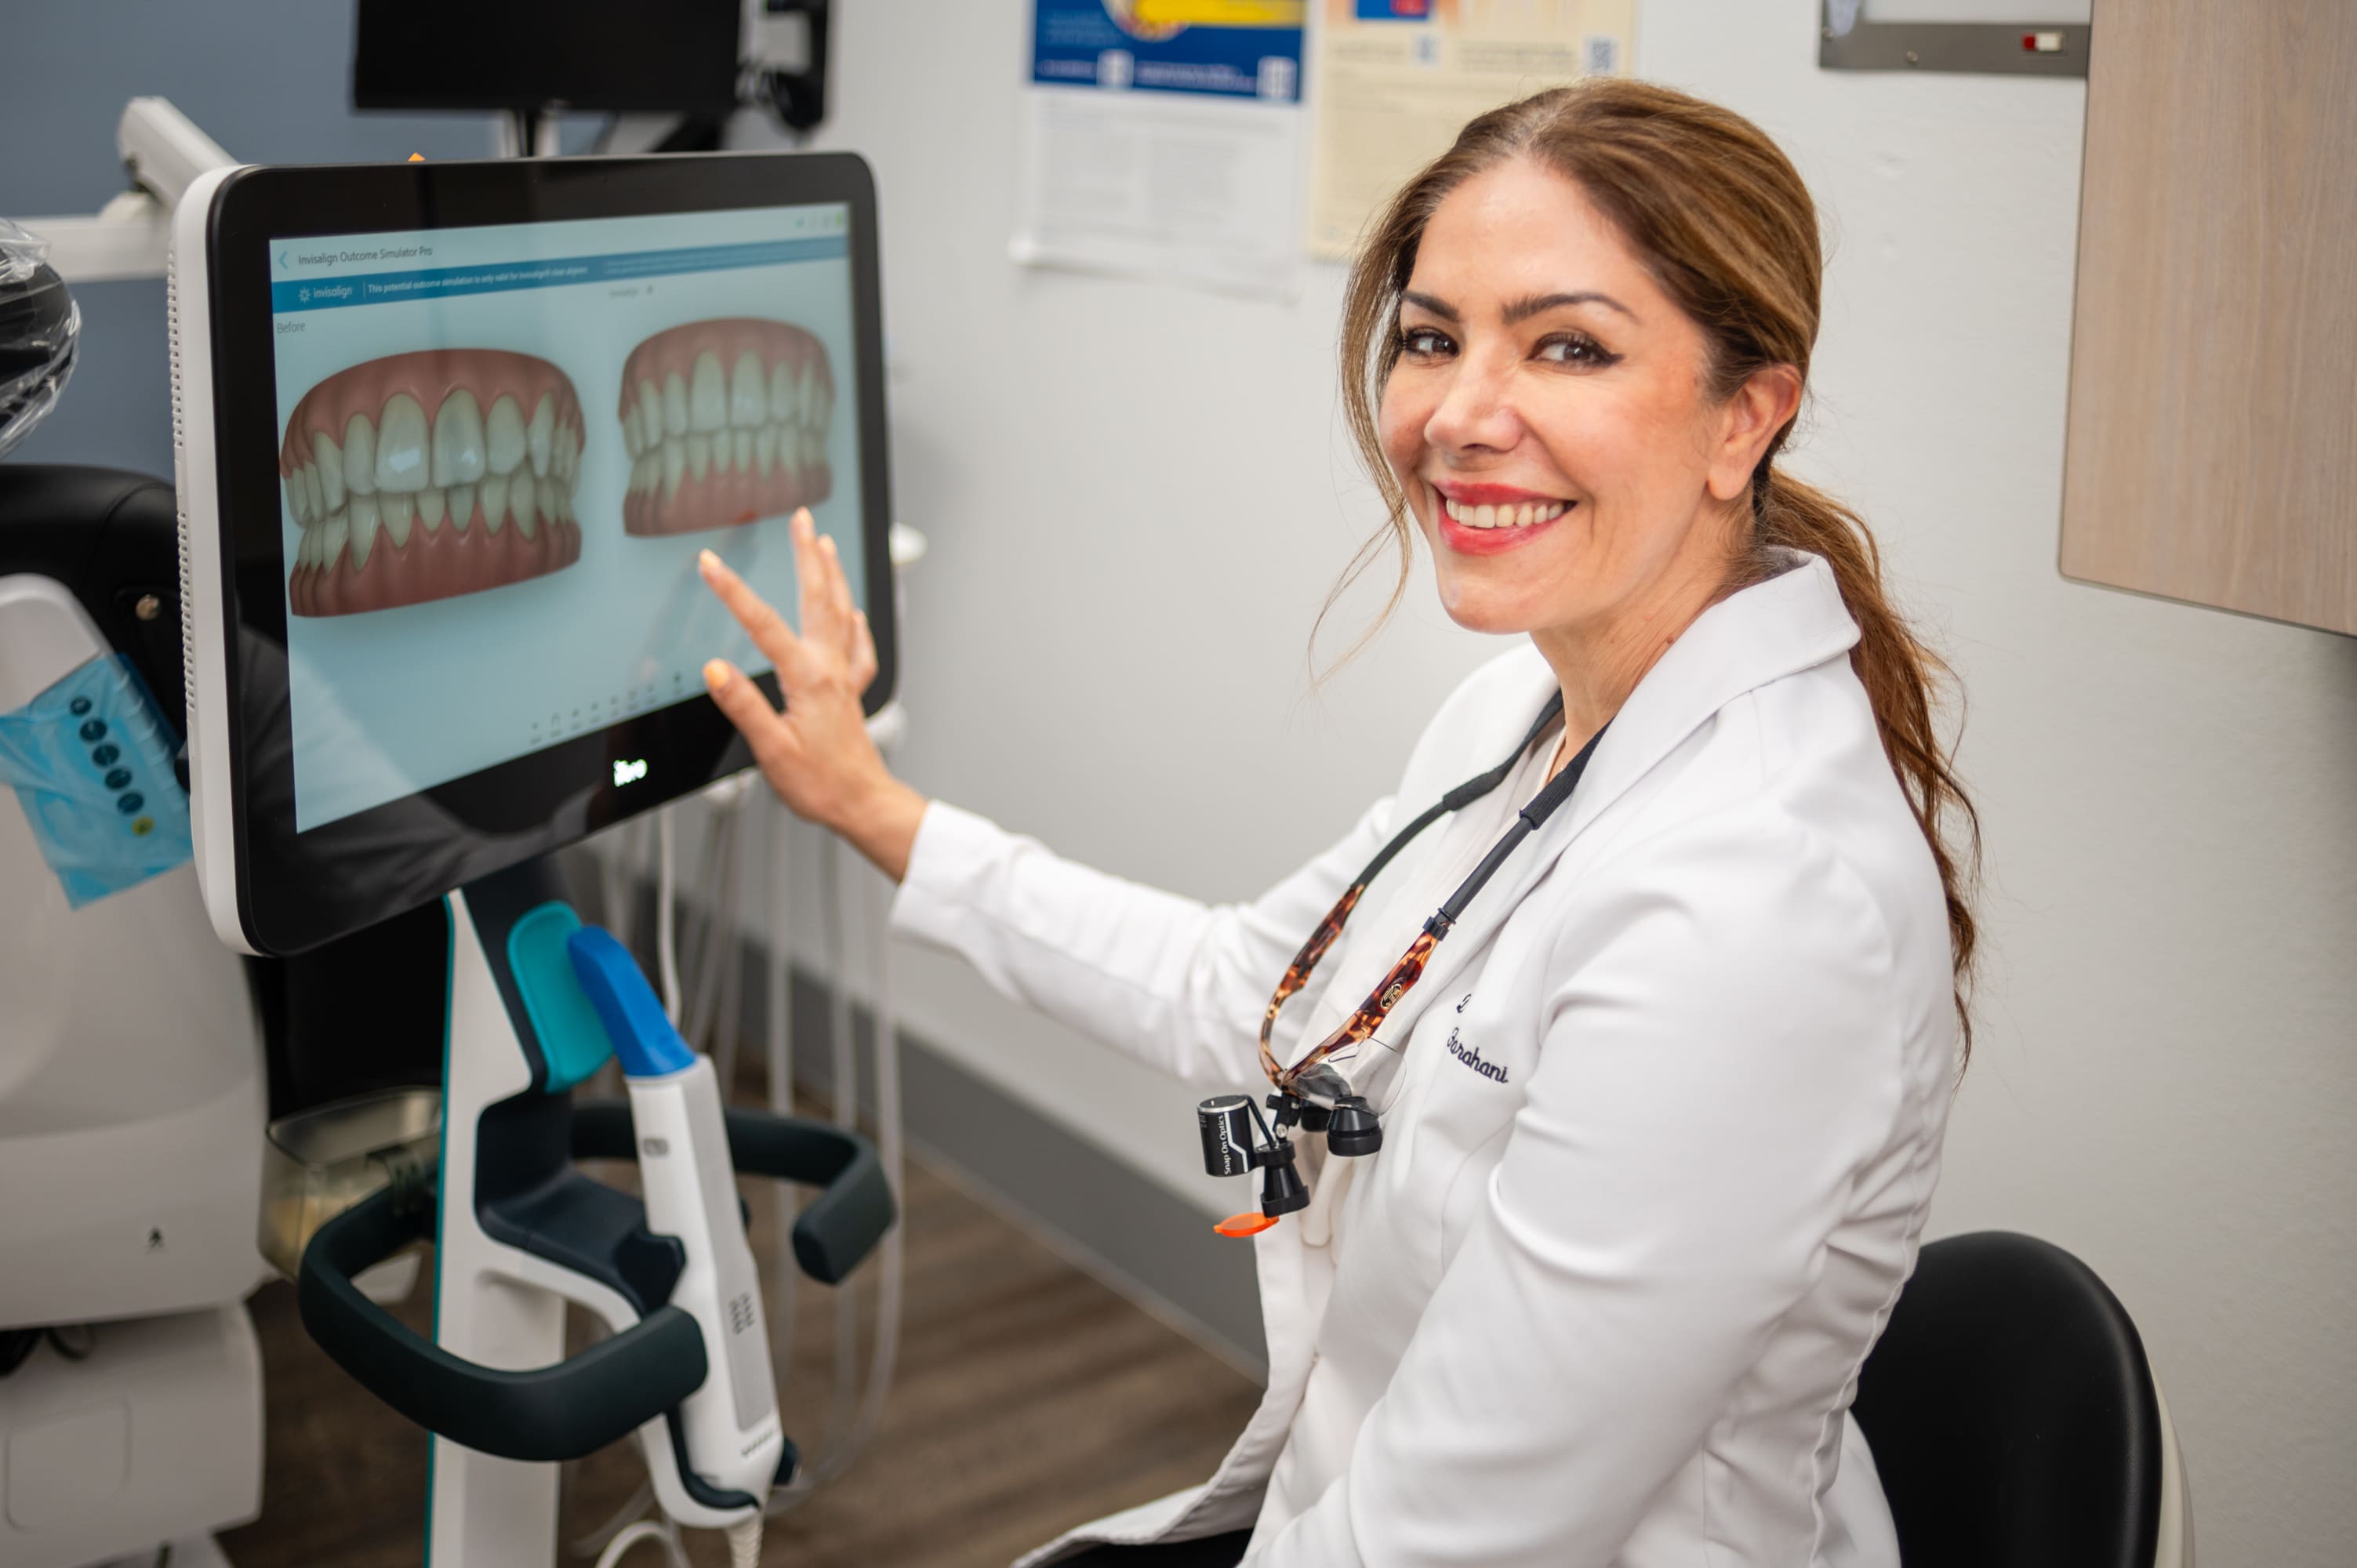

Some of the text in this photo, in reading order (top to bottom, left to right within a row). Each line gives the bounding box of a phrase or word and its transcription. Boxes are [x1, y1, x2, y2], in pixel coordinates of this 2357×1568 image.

[298, 245, 433, 267] Invisalign Outcome Simulator Pro
[313, 285, 353, 299] invisalign
[369, 283, 383, 294] This
[383, 281, 412, 294] potential
[413, 280, 441, 289] outcome
[277, 321, 306, 335] Before
[1218, 1114, 1232, 1175] Snap On Optics
